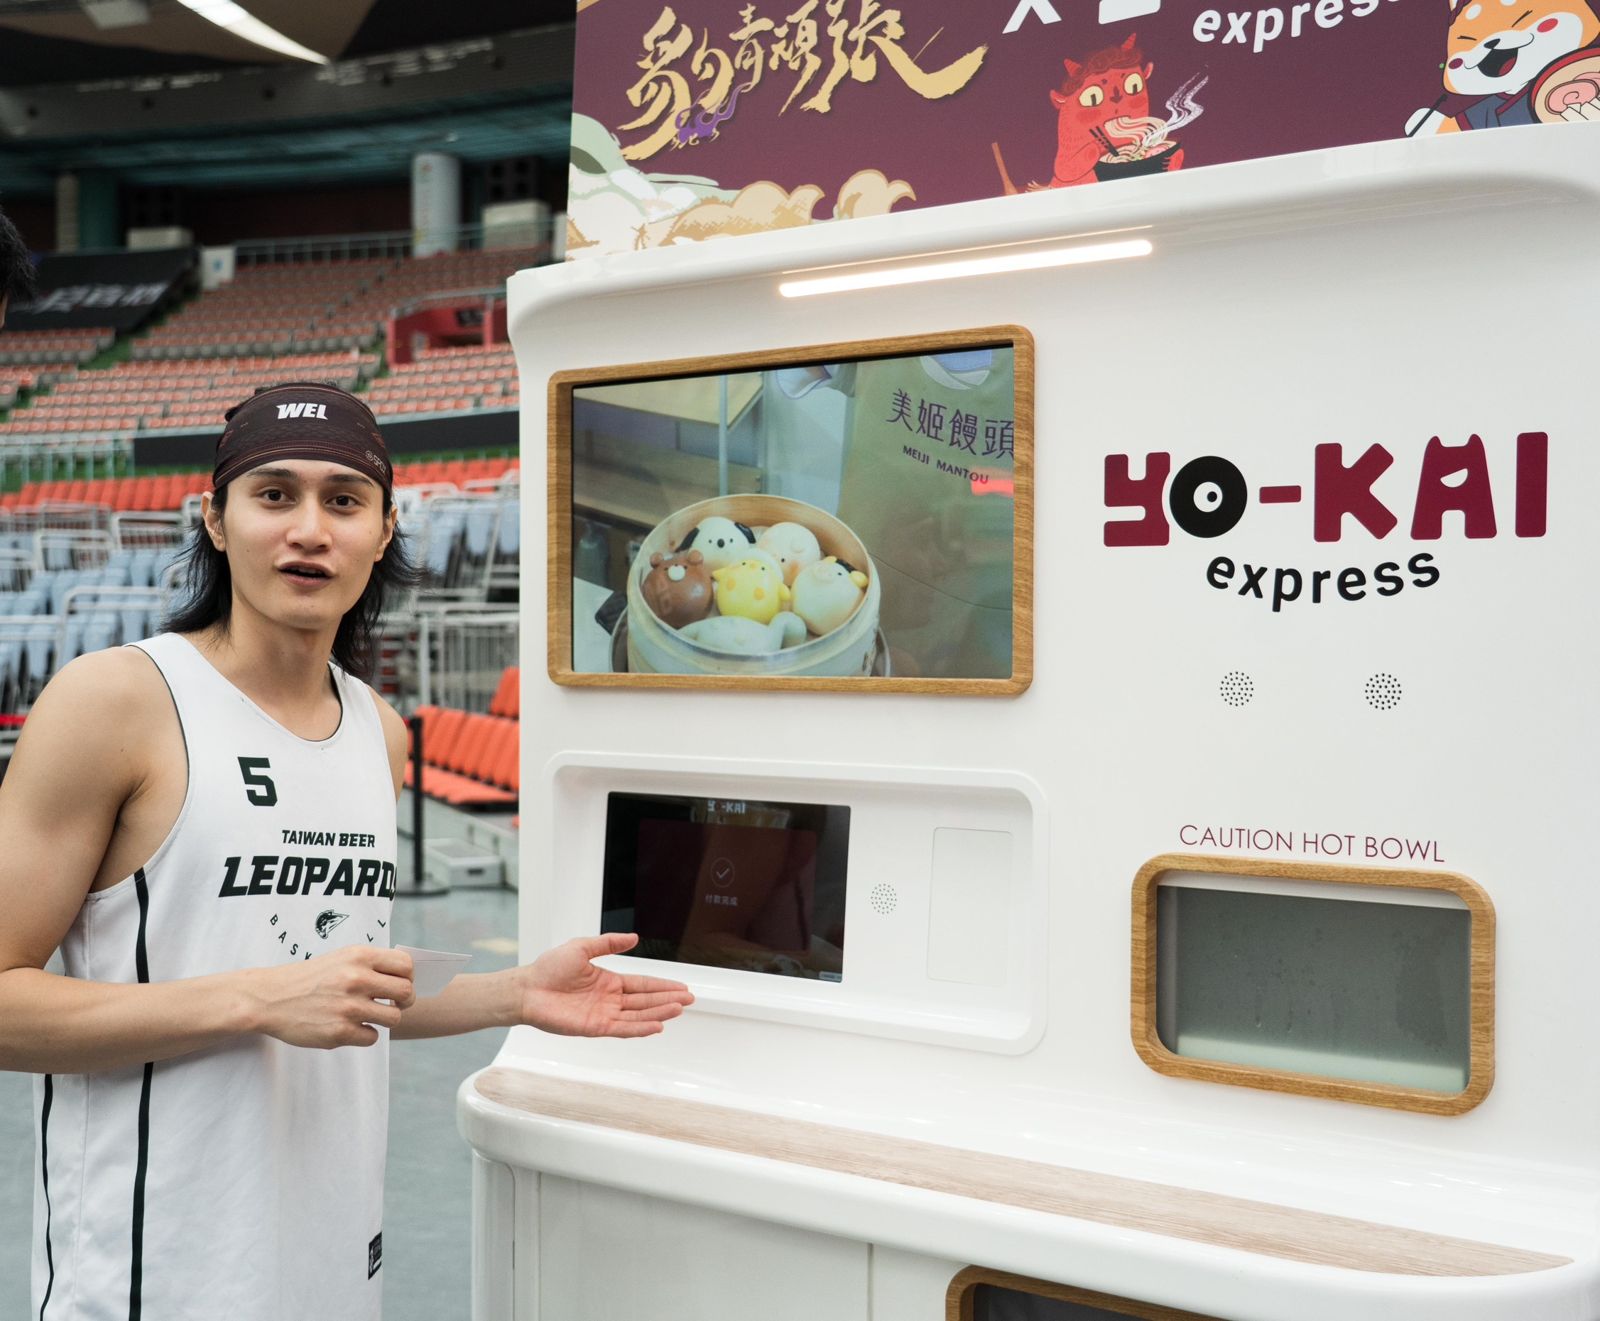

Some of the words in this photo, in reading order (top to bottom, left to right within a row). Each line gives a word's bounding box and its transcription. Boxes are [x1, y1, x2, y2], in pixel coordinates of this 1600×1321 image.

[1192, 0, 1400, 53] expres
[902, 445, 930, 465] MEIJI
[936, 459, 990, 485] MANTOU
[1103, 431, 1549, 547] YO-KAI
[1206, 552, 1441, 613] express
[237, 756, 278, 807] 5
[282, 829, 336, 847] TAIWAN
[338, 833, 376, 848] BEER
[1179, 824, 1293, 852] CAUTION
[1303, 832, 1356, 856] HOT
[1364, 836, 1445, 863] BOWL
